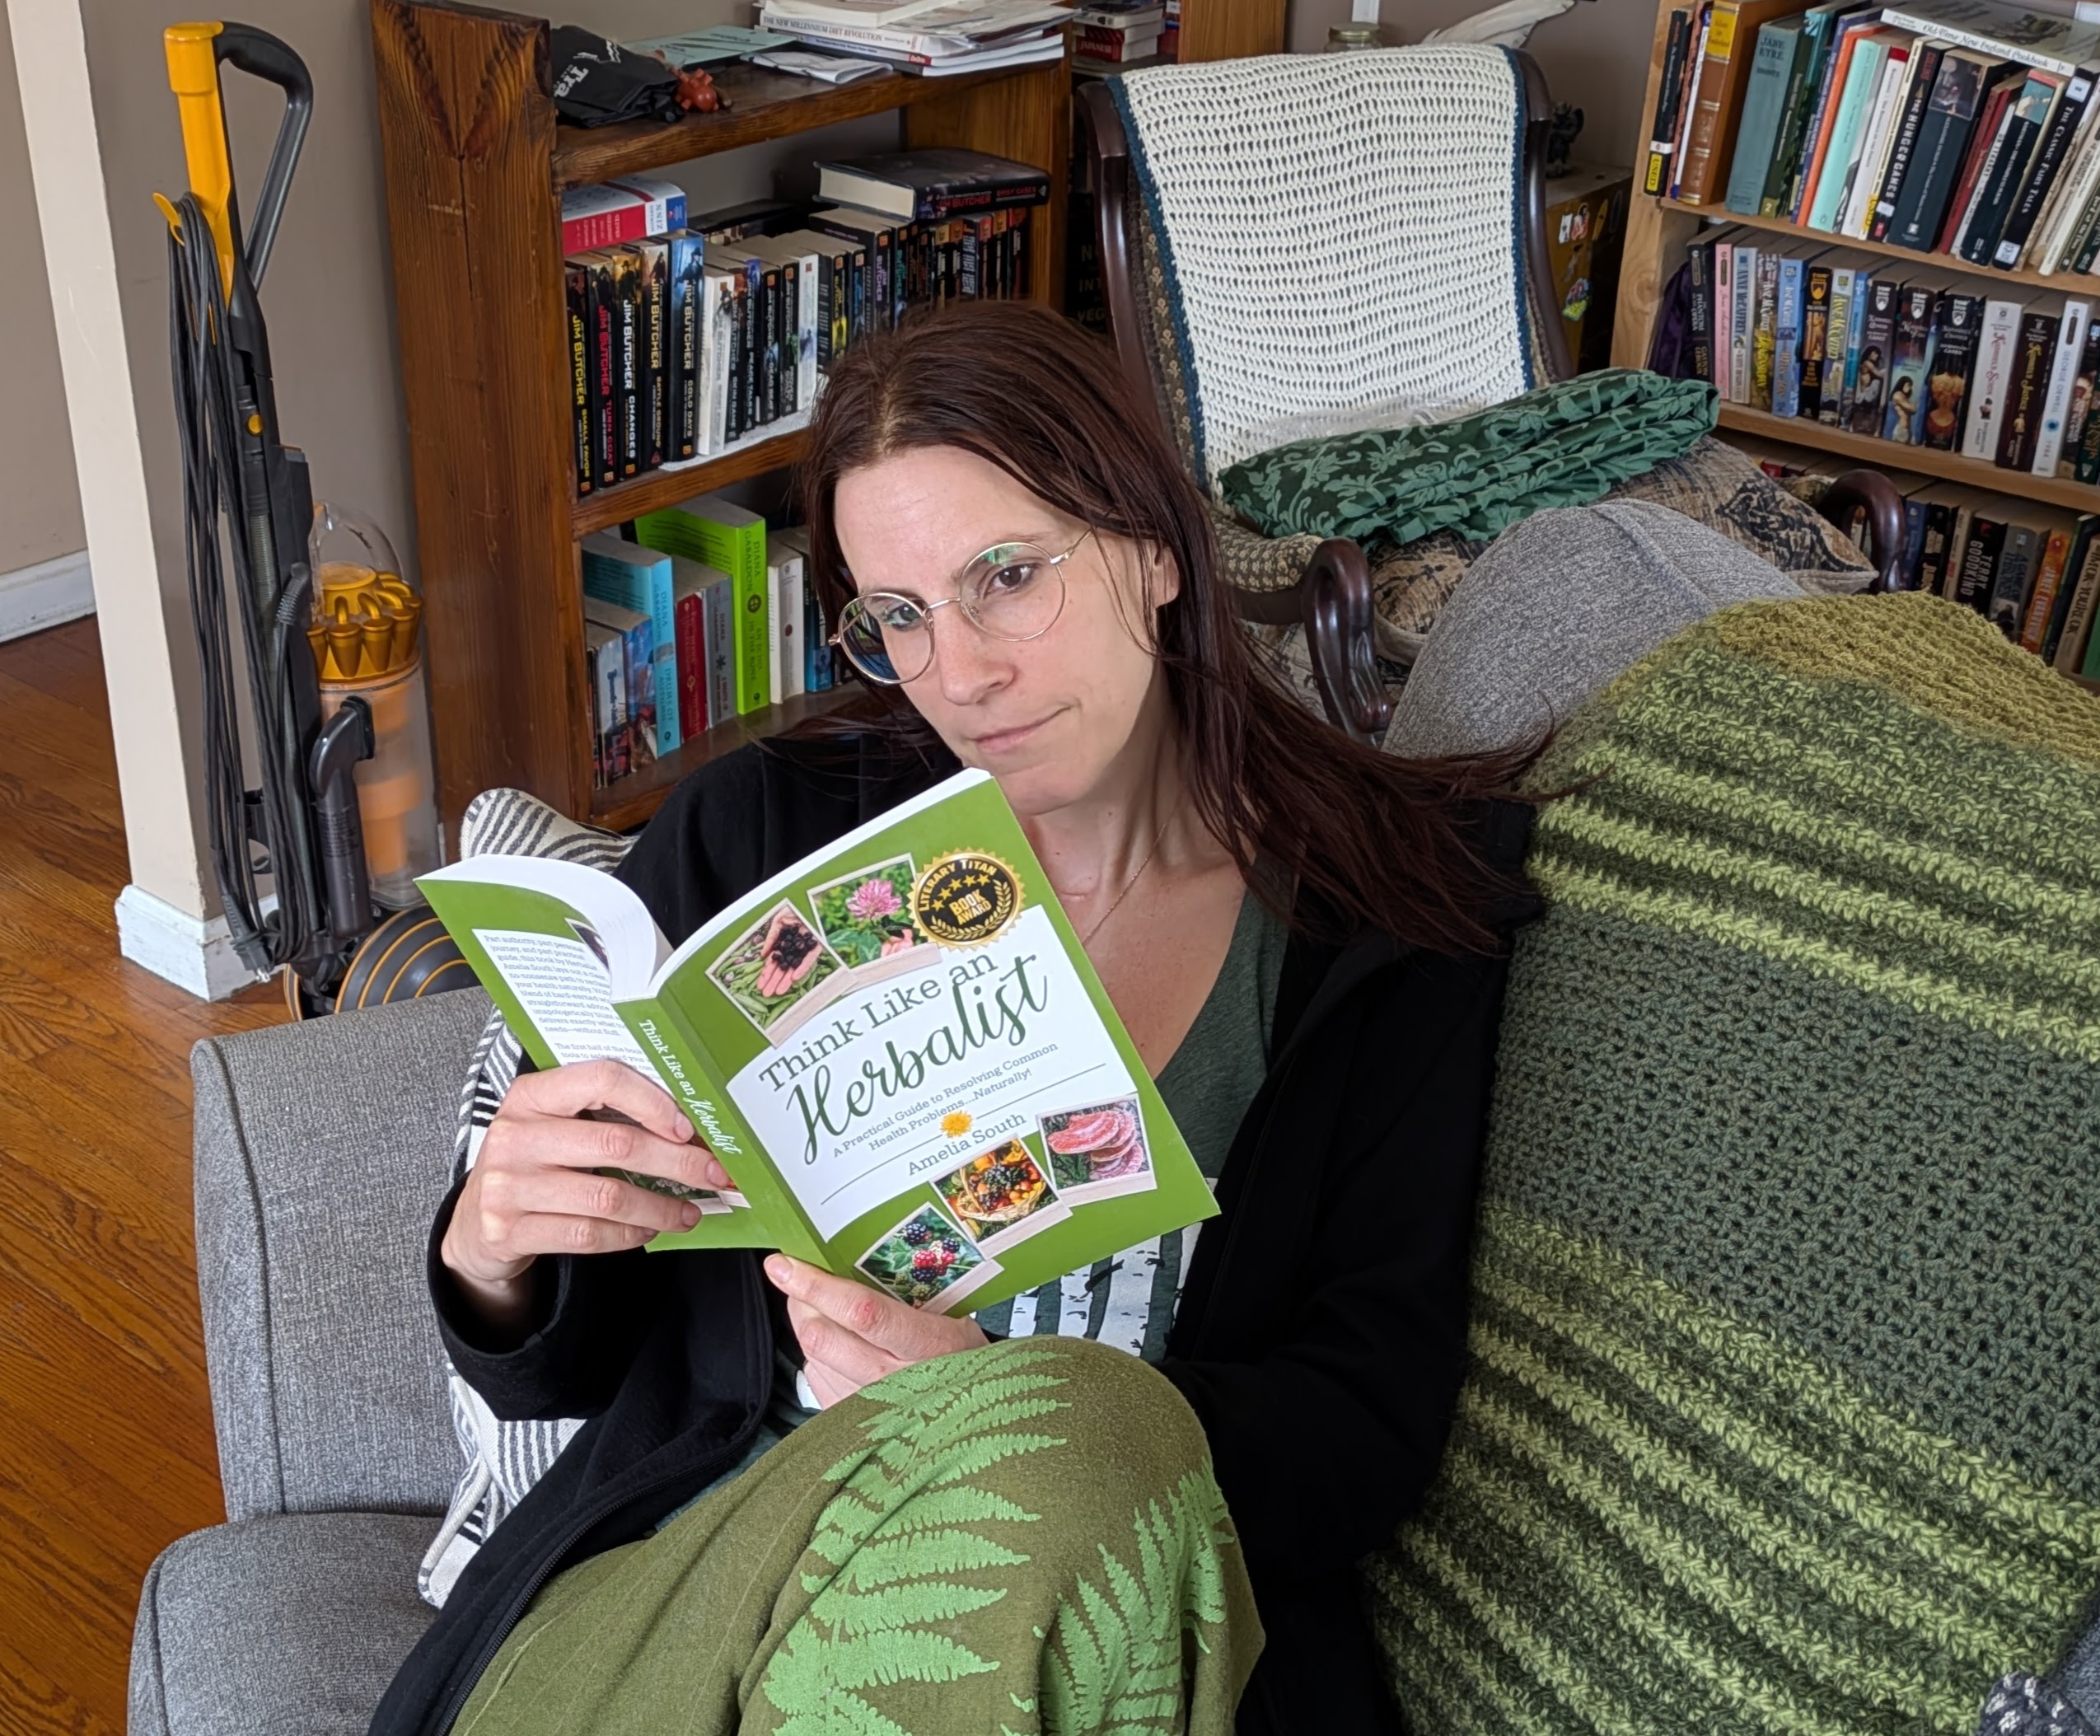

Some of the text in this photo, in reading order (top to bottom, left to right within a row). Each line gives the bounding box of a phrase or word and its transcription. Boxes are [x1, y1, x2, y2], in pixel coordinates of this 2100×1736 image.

[2059, 104, 2074, 124] THE
[1895, 113, 1918, 162] HUNGER
[1649, 157, 1660, 186] USED
[1884, 162, 1904, 199] GAMES
[1765, 204, 1772, 213] 2
[2020, 186, 2038, 215] TALES
[1734, 269, 1746, 335] ANNE McCAFFREY
[650, 278, 659, 368] JIM BUTCHER
[682, 279, 693, 369] JIM BUTCHER
[572, 315, 584, 405] JIM BUTCHER
[598, 304, 609, 395] JIM BUTCHER
[623, 299, 632, 389] JIM BUTCHER
[2050, 350, 2071, 414] GEORGE ORWELL
[2042, 440, 2052, 458] 1984
[744, 531, 754, 592] GABALDON
[752, 540, 761, 577] DIANA
[1959, 539, 1984, 596] GOODKIND
[1975, 554, 1994, 589] TERRY
[2038, 566, 2056, 594] JANET
[659, 591, 668, 626] DIANA
[2066, 618, 2081, 636] OK
[919, 859, 998, 912] LITERARY TITAN
[949, 888, 986, 916] BOOK
[956, 901, 992, 925] AWARD
[484, 935, 499, 943] Part
[498, 954, 519, 962] guide,
[558, 957, 564, 966] by
[504, 963, 529, 971] Amelia
[553, 966, 568, 976] lays
[533, 981, 557, 990] health
[560, 975, 576, 984] path
[759, 953, 999, 1092] Think Like an
[786, 953, 1047, 1165] Herbalist
[638, 1019, 743, 1154] Think Like an Herbalist
[833, 1042, 1058, 1158] A Practical Guide to Resolving Common
[868, 1125, 909, 1151] Health
[907, 1112, 1027, 1176] Amelia South
